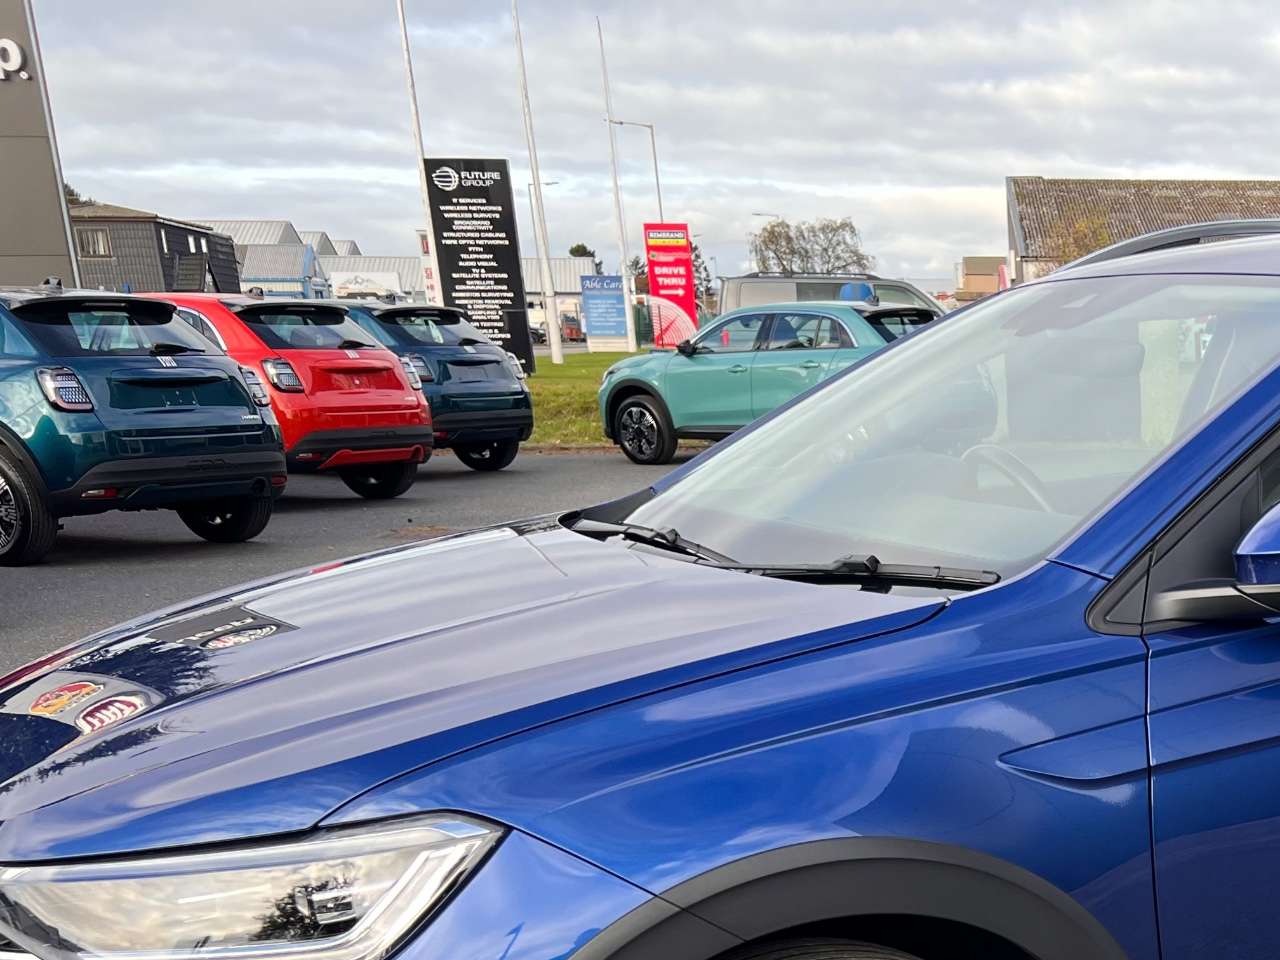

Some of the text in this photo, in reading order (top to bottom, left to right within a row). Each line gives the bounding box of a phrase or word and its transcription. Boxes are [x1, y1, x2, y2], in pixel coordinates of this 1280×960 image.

[461, 171, 501, 179] FUTURE
[654, 266, 686, 275] DRIVE
[583, 278, 601, 288] Able
[656, 277, 686, 286] THRU
